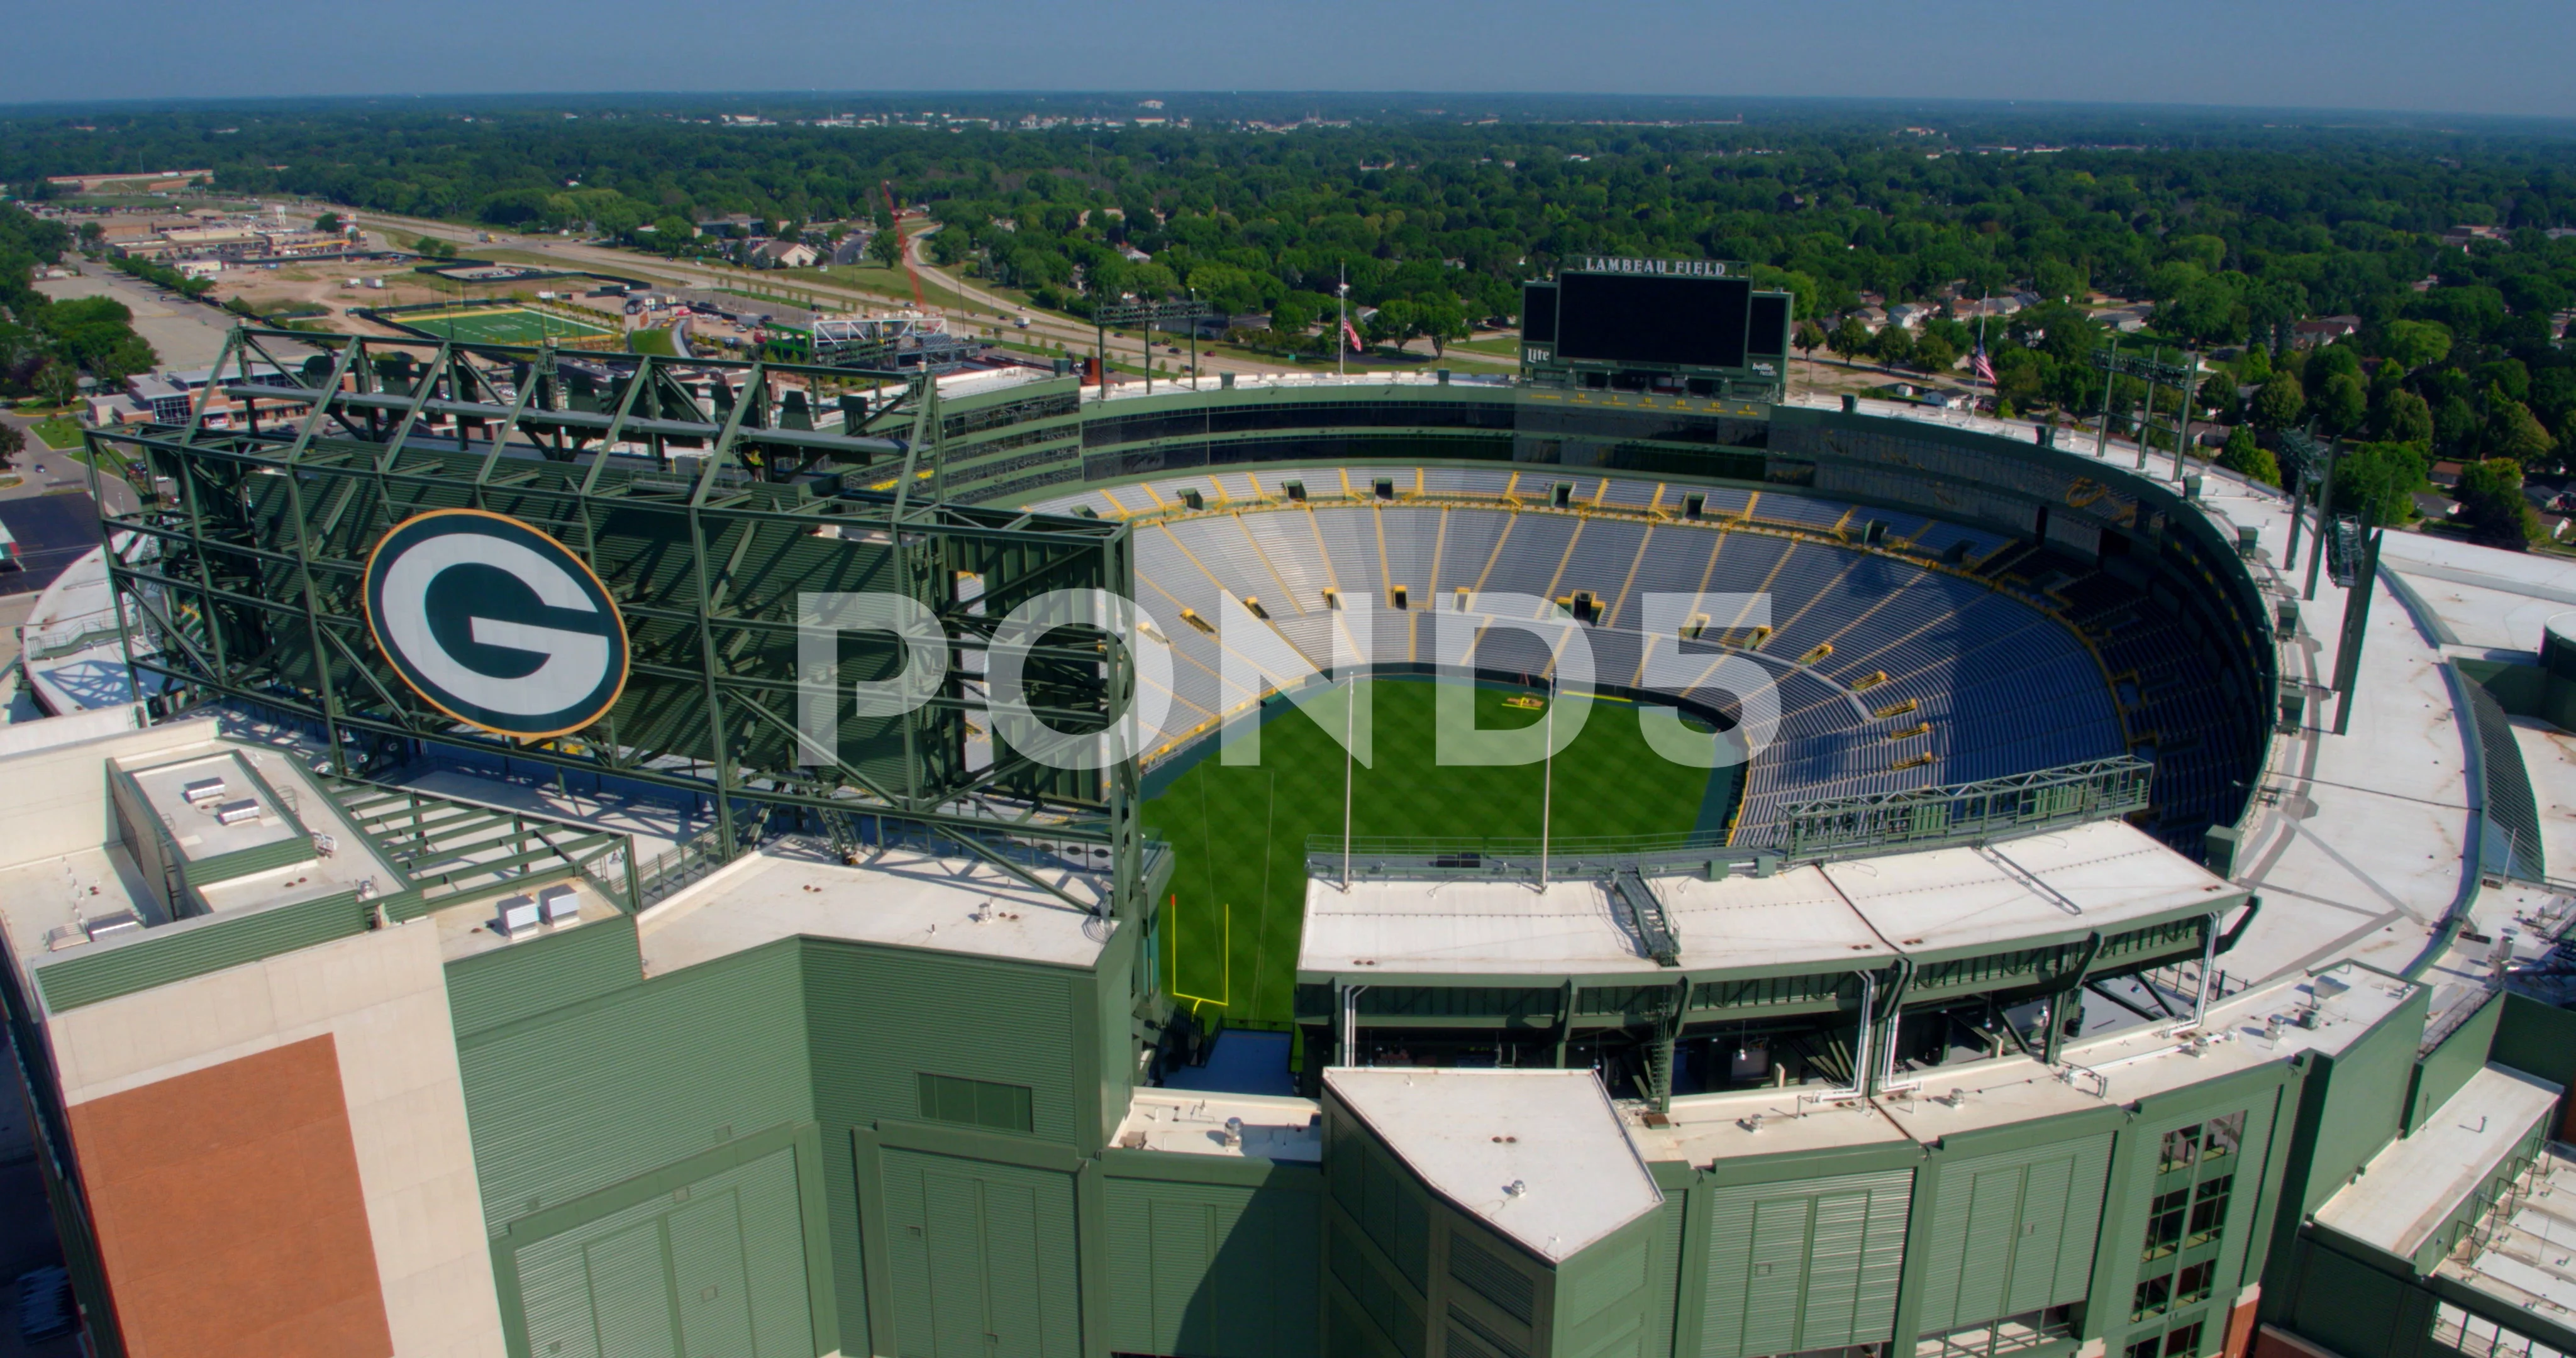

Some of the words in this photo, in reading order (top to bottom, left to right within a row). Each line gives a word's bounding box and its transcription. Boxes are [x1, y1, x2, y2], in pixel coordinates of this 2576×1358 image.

[1586, 258, 1666, 274] LAMBEAU
[1675, 261, 1726, 276] FIELD
[1527, 348, 1550, 363] Lite
[382, 533, 609, 715] G
